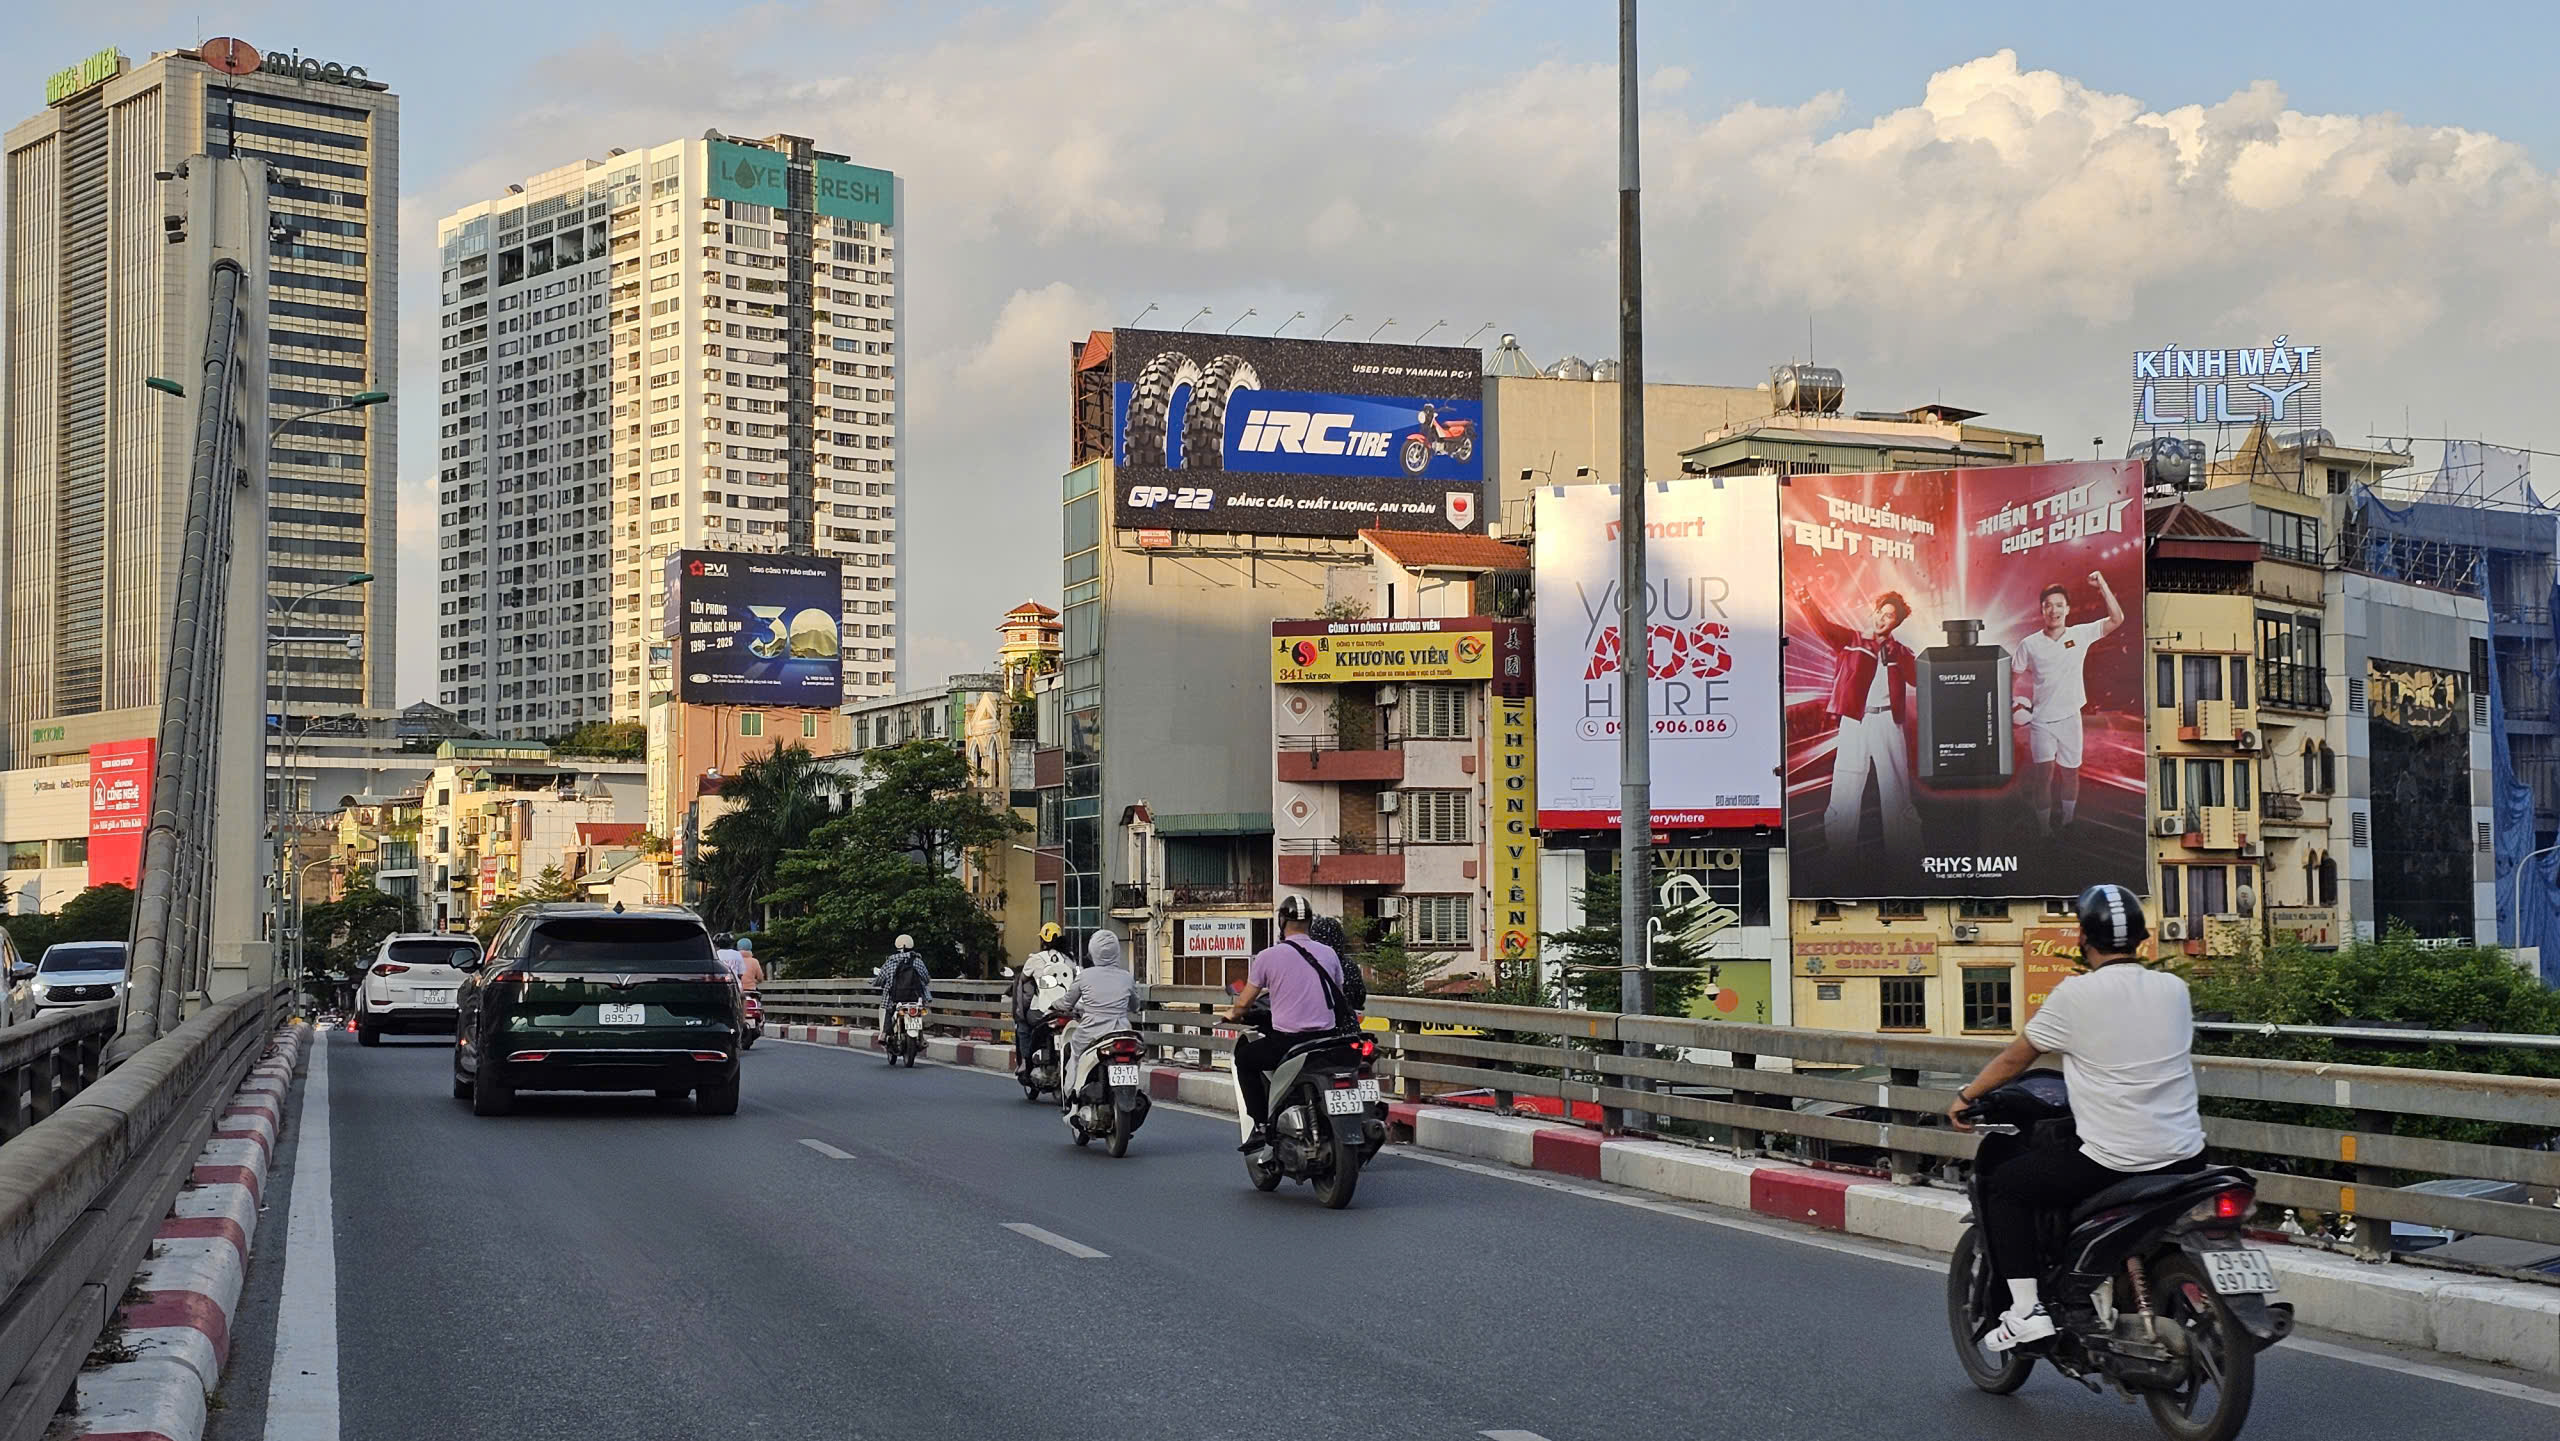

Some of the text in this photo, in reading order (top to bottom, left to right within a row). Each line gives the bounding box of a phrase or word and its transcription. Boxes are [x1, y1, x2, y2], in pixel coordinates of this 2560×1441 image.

[267, 48, 368, 87] mipec
[821, 177, 880, 205] RESH
[2136, 334, 2315, 378] KÍNH MẮT
[1352, 364, 1473, 380] USED FOR YAMAHA PG-1
[2143, 381, 2310, 424] LILY
[1346, 431, 1393, 458] TIRE
[1128, 485, 1214, 511] GP-22
[1379, 502, 1399, 513] AN
[1401, 499, 1436, 514] TOÀN
[1976, 480, 2101, 536] KIẾN TẠO
[1789, 519, 1915, 562] BỨT PHÁ
[2001, 527, 2044, 555] CUỘC
[704, 563, 727, 573] PVI
[705, 602, 728, 616] PHONG
[690, 618, 713, 634] KHÔNG
[747, 605, 839, 662] 30
[1327, 621, 1349, 634] CÔNG
[1349, 623, 1360, 633] TY
[1382, 622, 1388, 632] Y
[1389, 620, 1421, 632] KHƯƠNG
[1421, 619, 1441, 631] VIÊN
[690, 640, 706, 653] 1996
[716, 636, 734, 649] 2026
[1335, 645, 1449, 666] KHƯƠNG VIÊN
[1279, 668, 1304, 681] 341
[1585, 680, 1729, 717] HRE
[1605, 719, 1728, 735] 09.906.086
[1503, 711, 1526, 835] KHƯƠNG
[1649, 813, 1705, 825] verywhere
[1923, 855, 2018, 873] RHYS MAN
[1507, 845, 1526, 926] VIÊN
[1227, 934, 1245, 951] MÁY
[1887, 937, 1936, 955] LÂM
[1835, 959, 1900, 969] SINH
[612, 1003, 631, 1013] 30F
[604, 1014, 640, 1023] 895.37
[1111, 1075, 1138, 1084] 427.15
[1330, 1101, 1361, 1113] 355.37
